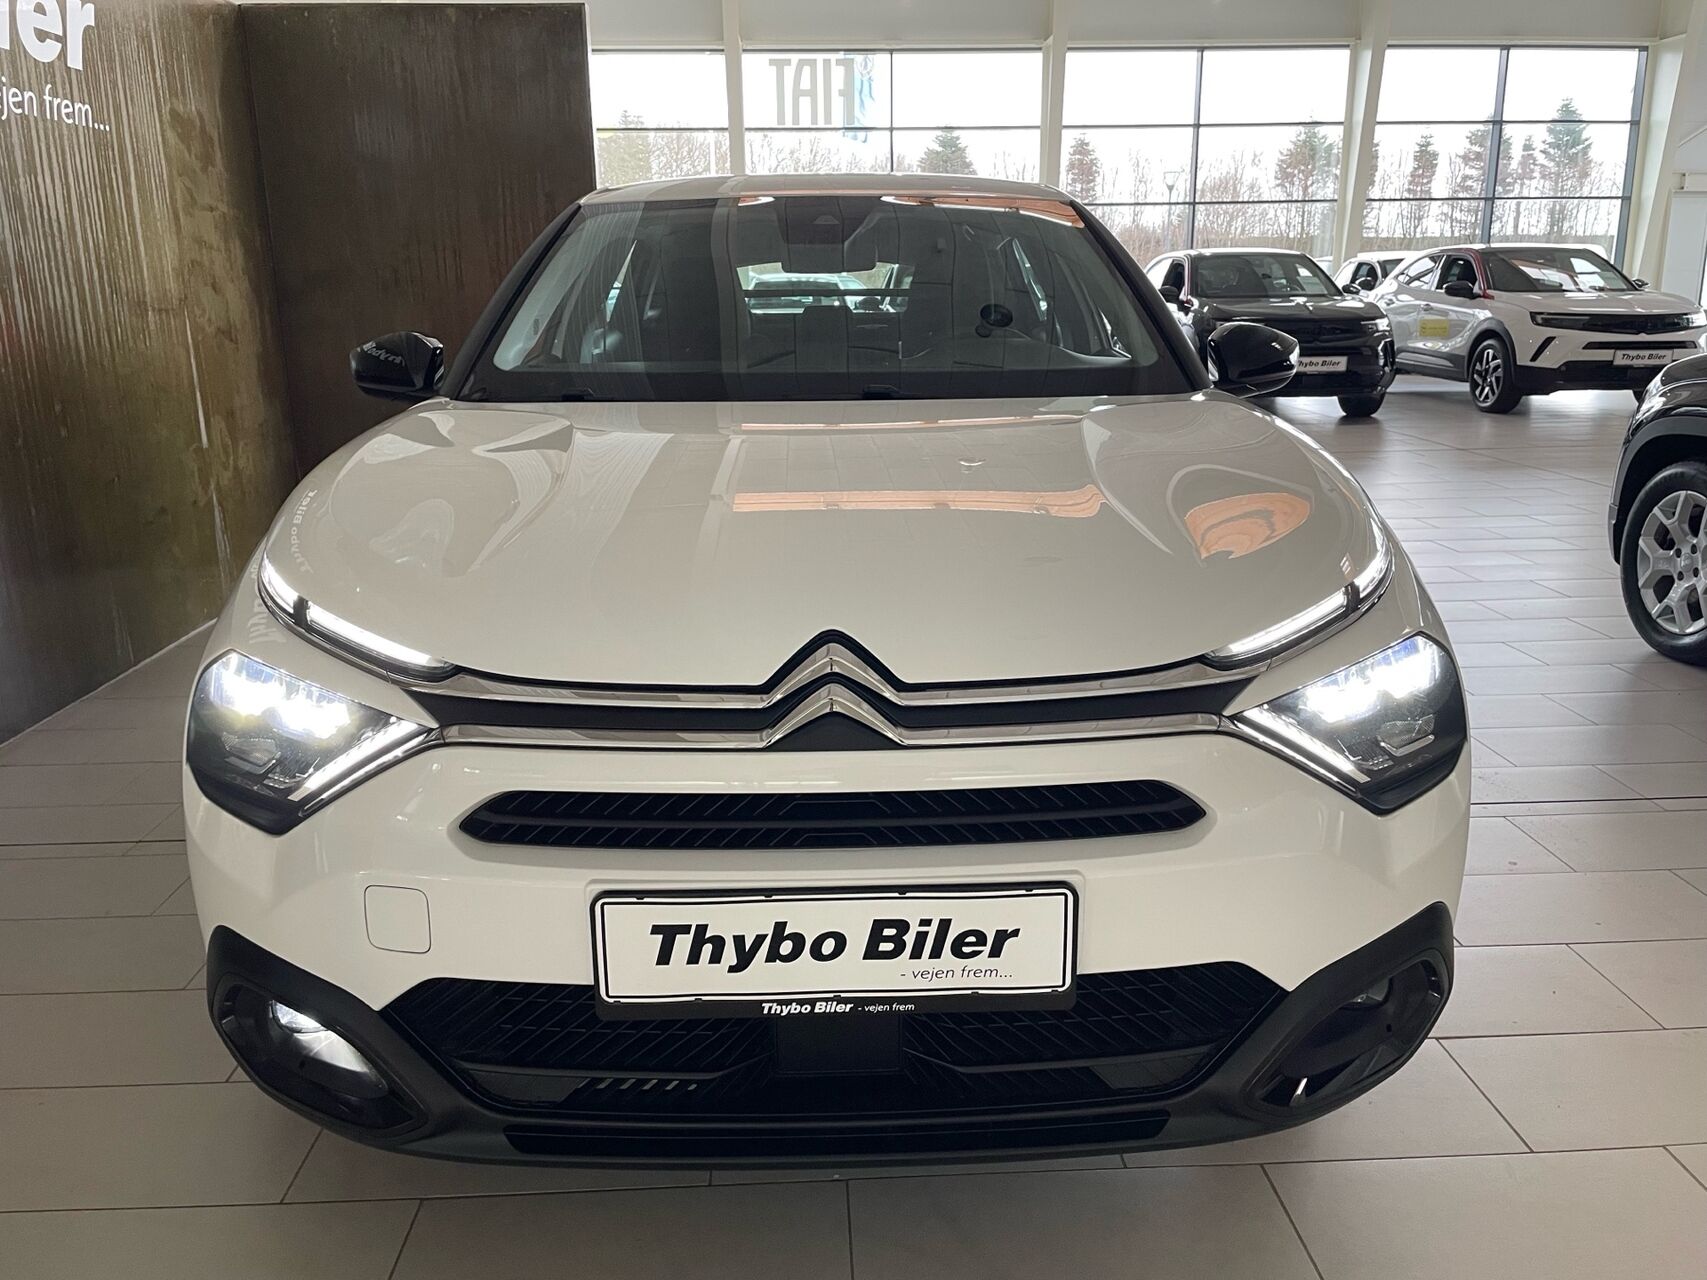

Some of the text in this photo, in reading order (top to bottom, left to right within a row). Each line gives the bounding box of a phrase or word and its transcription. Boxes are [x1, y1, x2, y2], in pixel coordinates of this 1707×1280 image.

[0, 76, 110, 131] jen frem...
[1320, 359, 1342, 367] Biler
[649, 918, 1021, 974] Thybo Biler
[911, 967, 955, 983] vejen
[960, 964, 1013, 979] frem...
[761, 1002, 812, 1017] Thybo
[814, 1001, 854, 1014] Biler
[864, 1003, 891, 1014] vejen
[892, 1002, 915, 1012] frem
